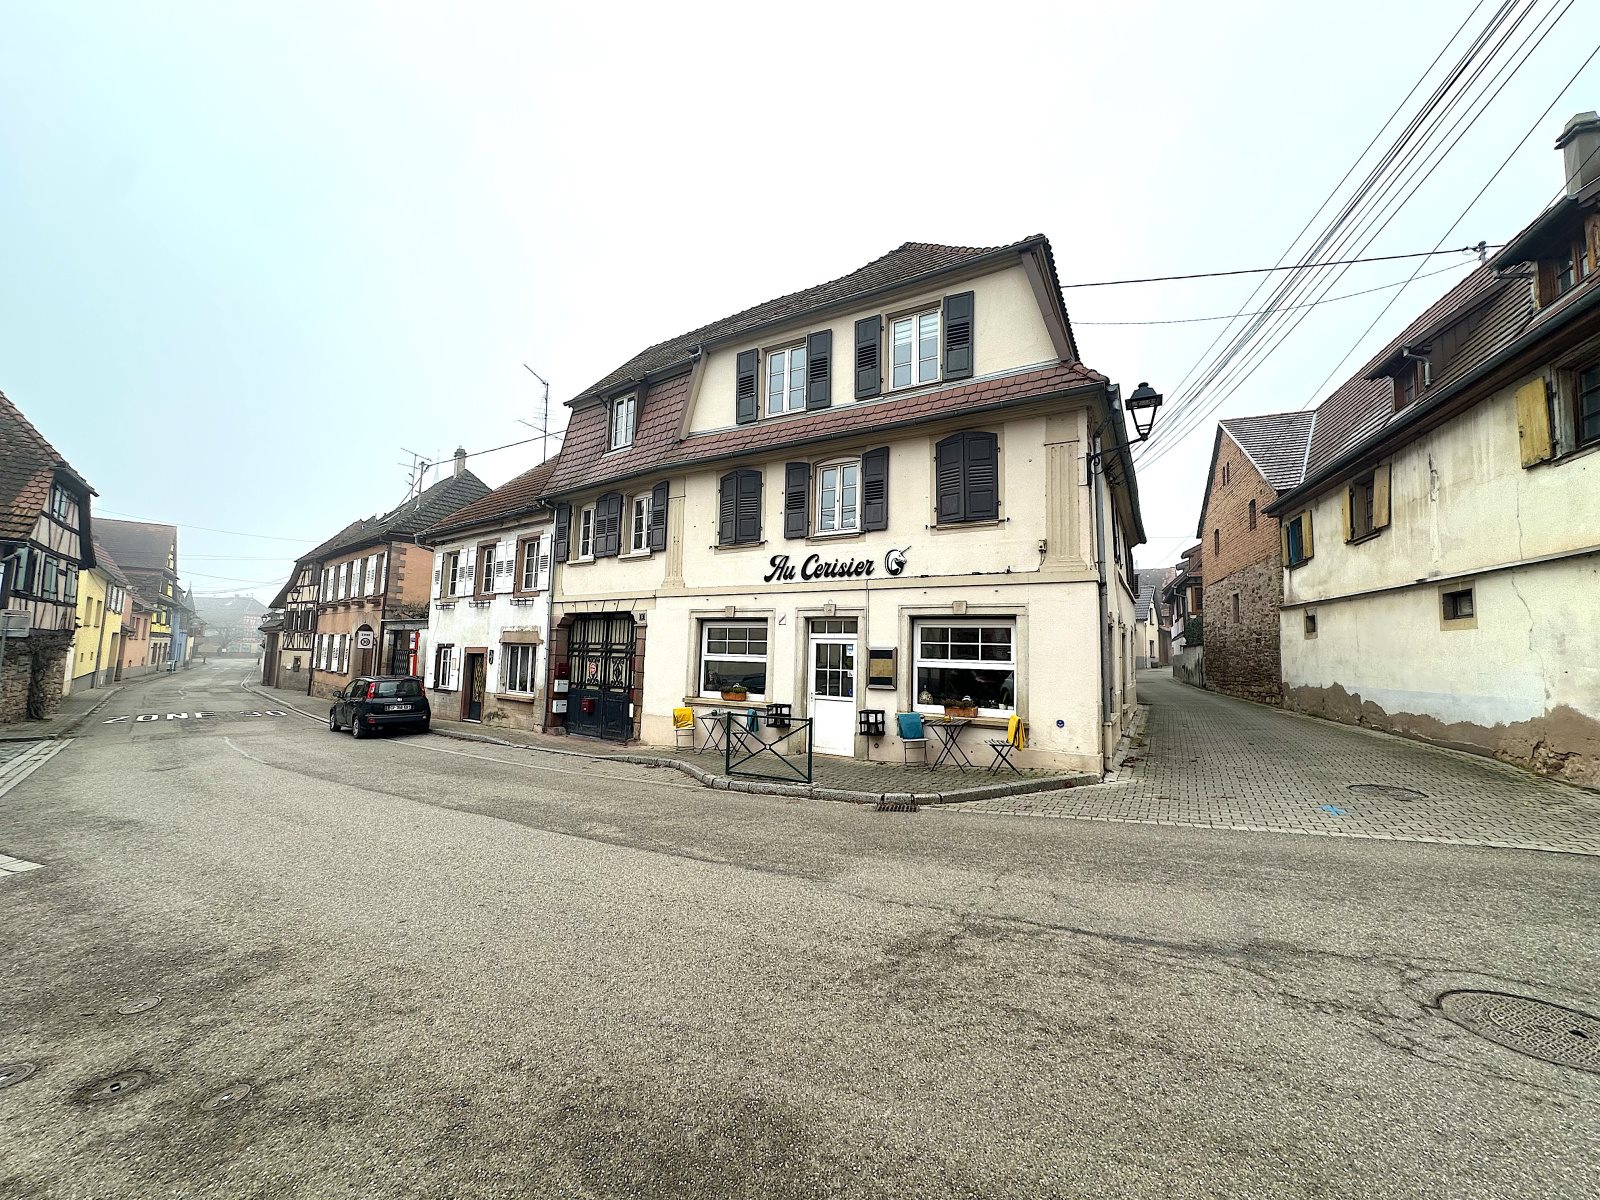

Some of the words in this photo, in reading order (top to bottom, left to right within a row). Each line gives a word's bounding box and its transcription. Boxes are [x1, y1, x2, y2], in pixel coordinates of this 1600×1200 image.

[764, 555, 796, 582] Au
[801, 553, 875, 581] Cerisier
[102, 711, 216, 724] ZONE
